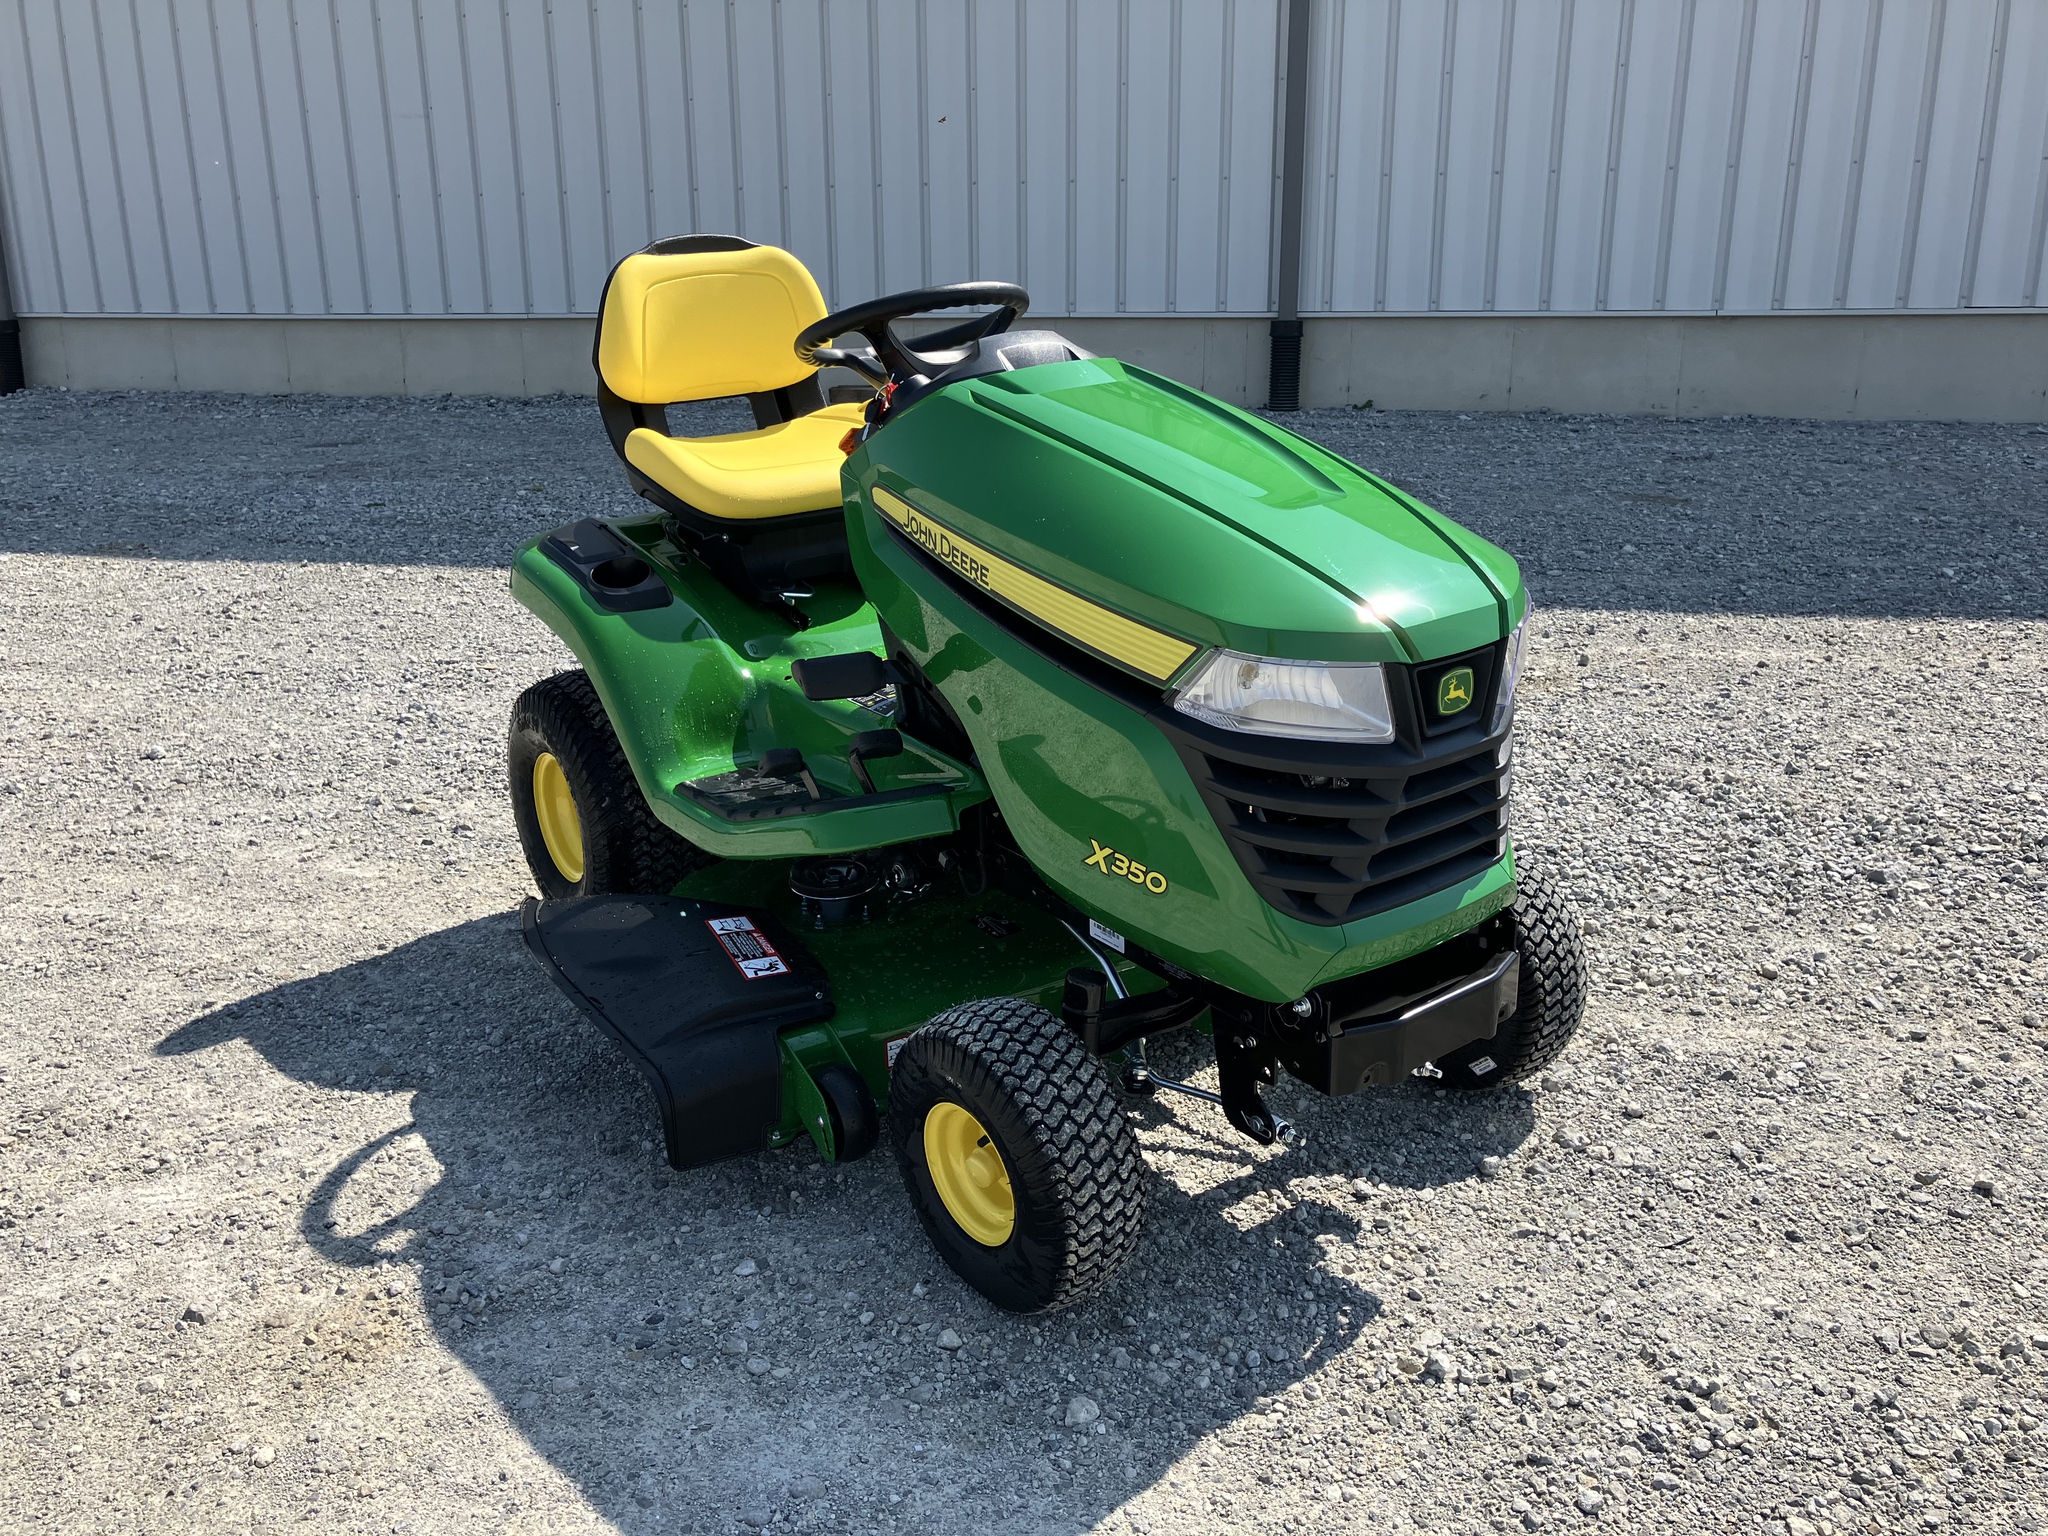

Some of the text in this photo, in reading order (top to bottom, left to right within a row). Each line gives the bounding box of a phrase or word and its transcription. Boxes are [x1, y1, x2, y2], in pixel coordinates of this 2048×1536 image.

[903, 508, 991, 588] JOHN DEERE
[1082, 837, 1168, 894] X350
[756, 936, 775, 953] DANGER
